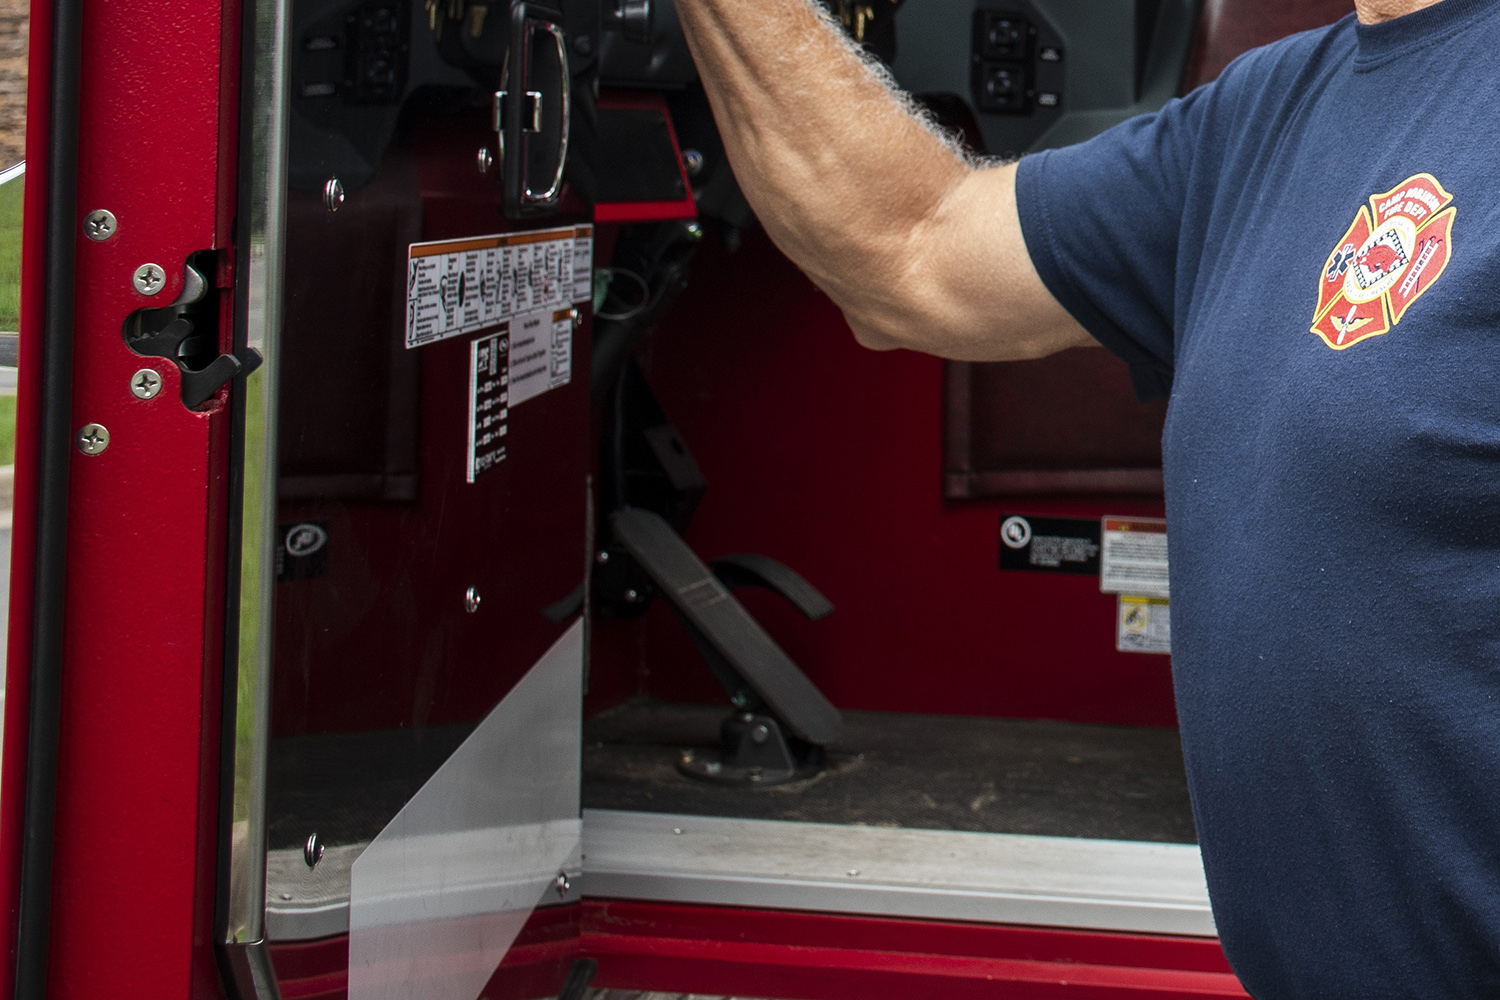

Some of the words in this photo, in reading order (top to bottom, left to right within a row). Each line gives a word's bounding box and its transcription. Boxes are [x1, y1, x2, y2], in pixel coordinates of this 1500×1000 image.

[1378, 190, 1406, 213] CAMP
[1404, 186, 1441, 213] ROBINSON
[1383, 200, 1406, 220] FIRE
[1403, 200, 1428, 220] DEPT
